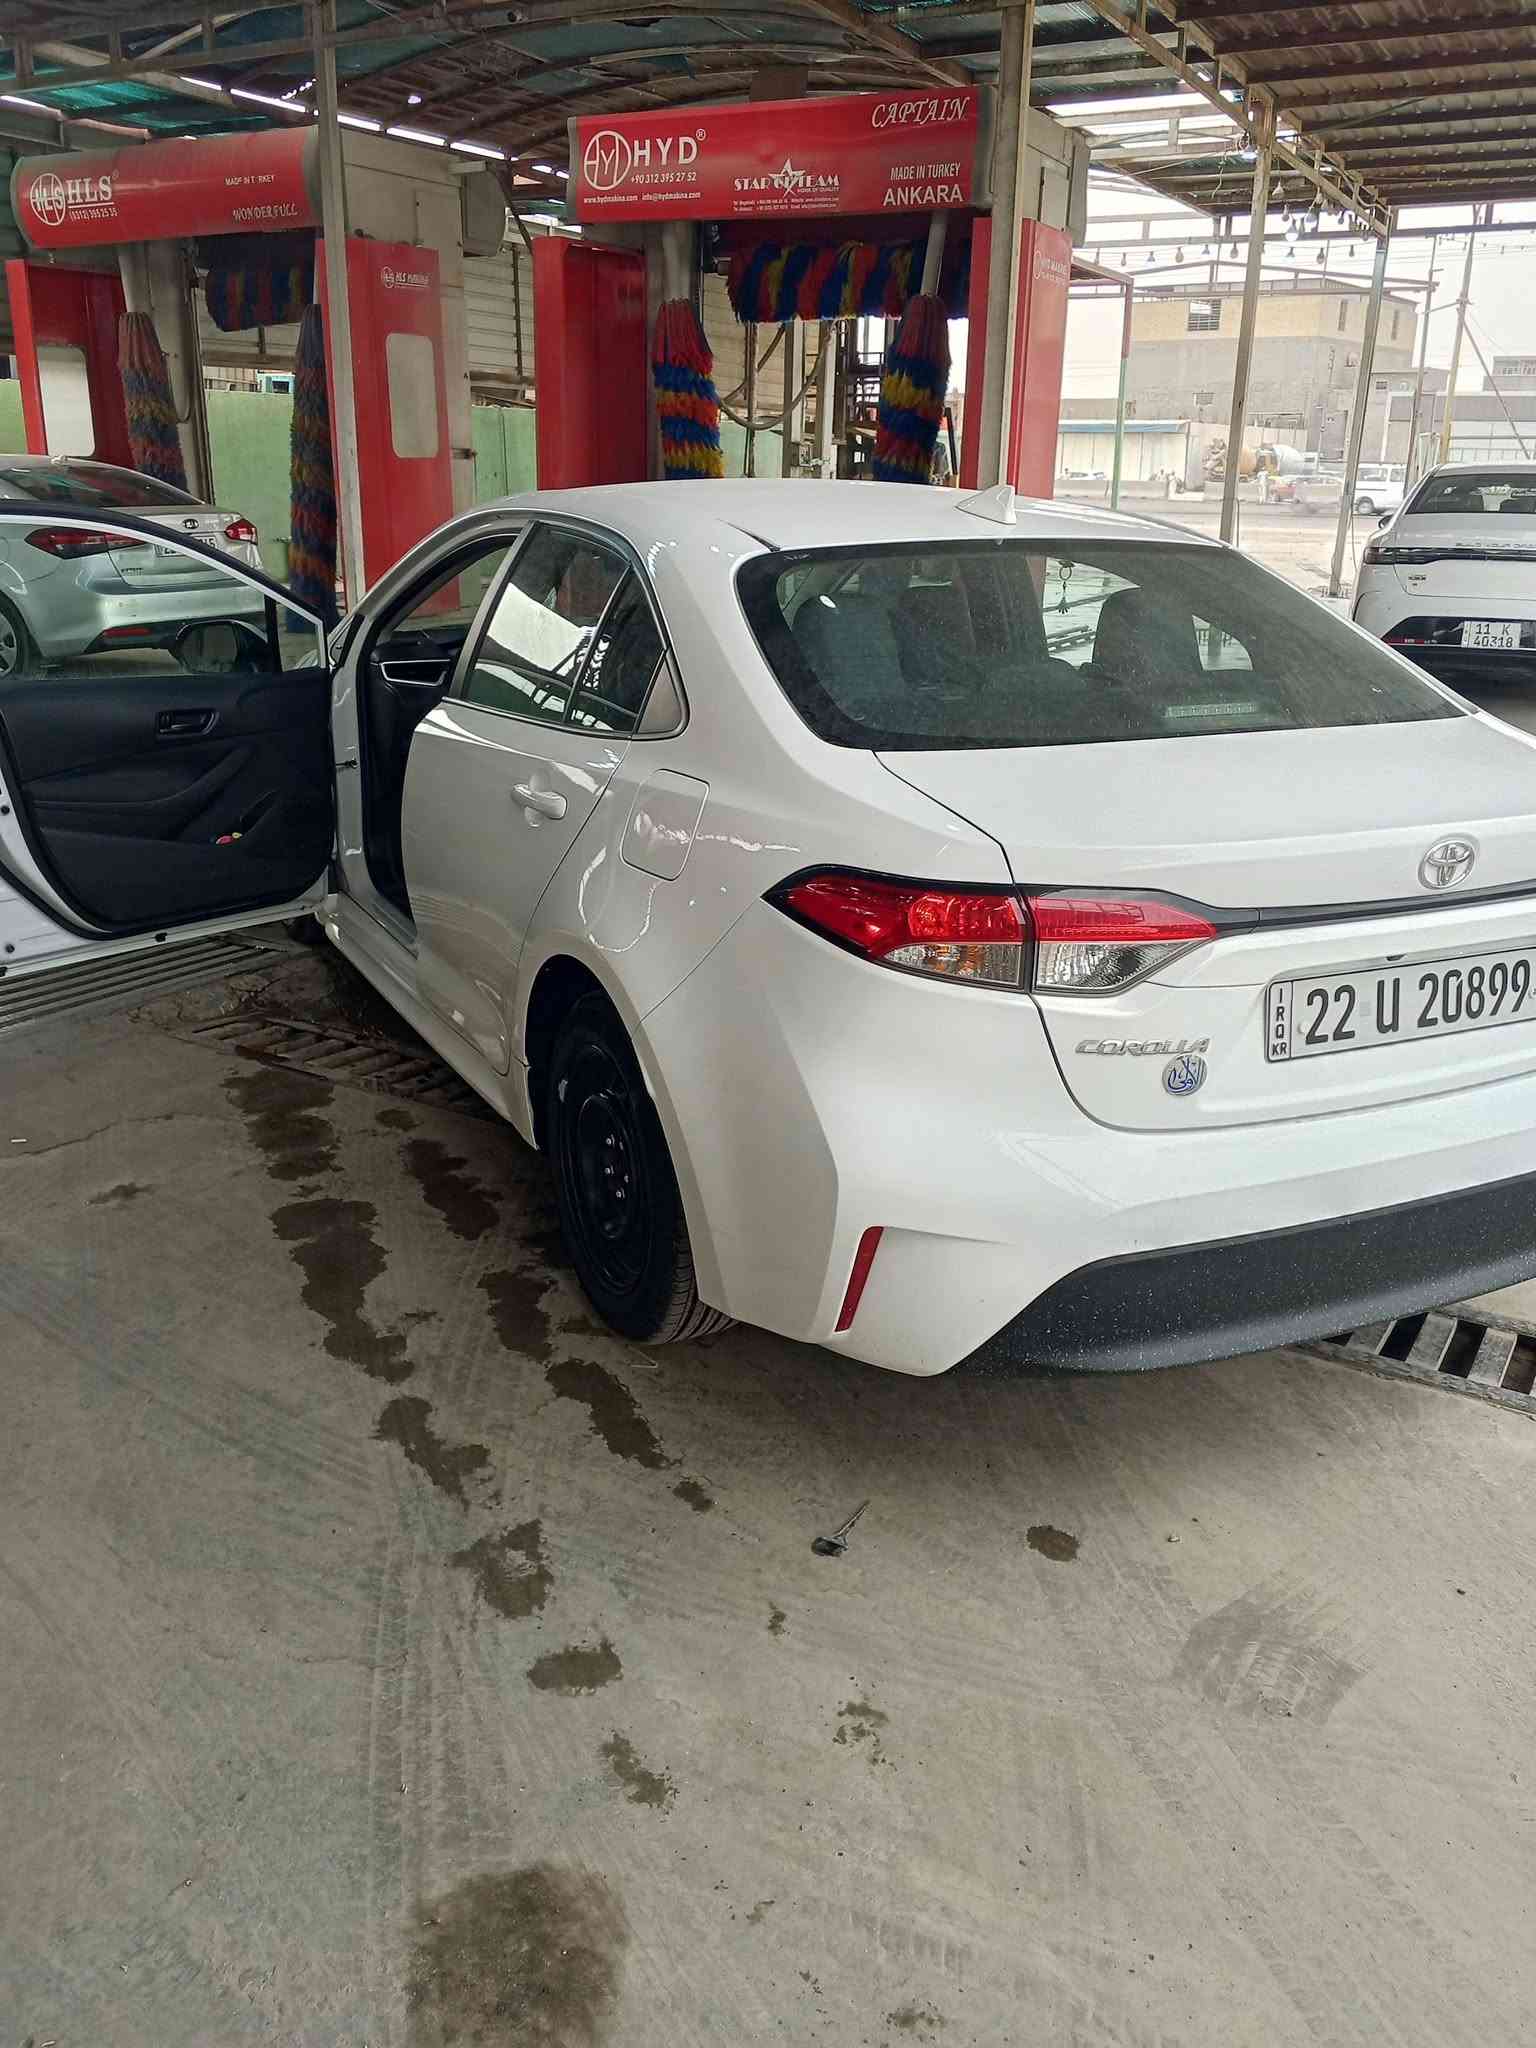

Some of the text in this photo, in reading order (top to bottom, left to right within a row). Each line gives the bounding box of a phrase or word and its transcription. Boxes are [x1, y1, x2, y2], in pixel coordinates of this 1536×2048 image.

[871, 97, 970, 128] CAPTAIN
[633, 136, 698, 168] HYD
[251, 174, 276, 184] TRKEY
[631, 172, 697, 184] +90 312 395 27 52
[890, 161, 961, 181] MADE IN TURKEY
[65, 175, 112, 204] HLS
[734, 177, 771, 192] STAR
[798, 174, 840, 188] TEAM
[883, 184, 963, 206] ANKARA
[1475, 623, 1491, 635] 11
[1501, 624, 1510, 636] K
[1473, 636, 1514, 649] 40318
[1306, 959, 1531, 1045] 22 U 20899
[1074, 1037, 1210, 1057] COROLLA
[1272, 1042, 1287, 1056] KR
